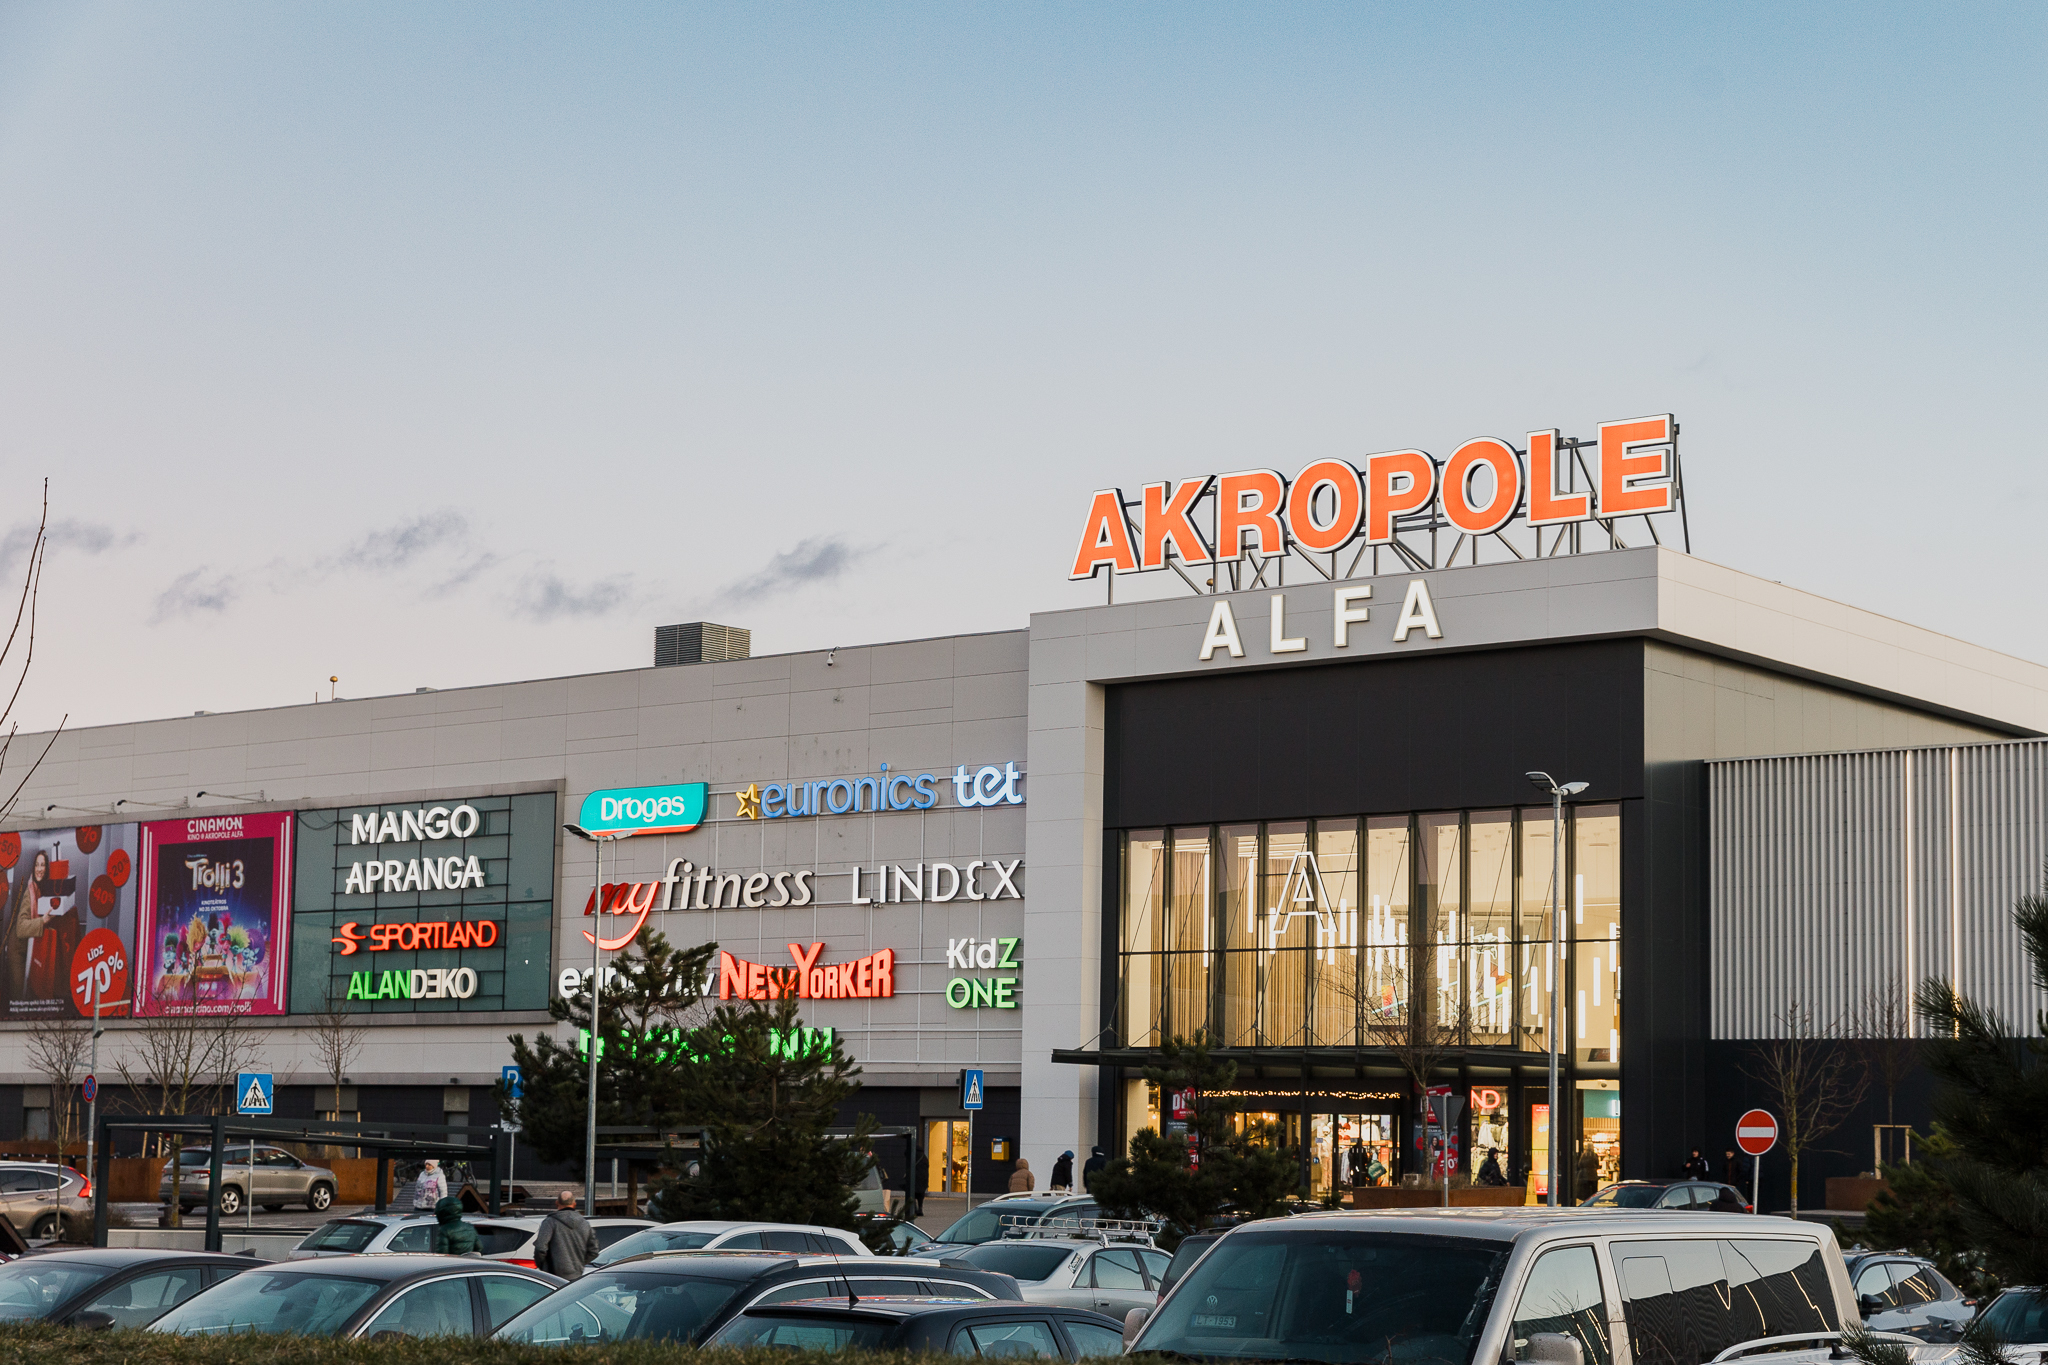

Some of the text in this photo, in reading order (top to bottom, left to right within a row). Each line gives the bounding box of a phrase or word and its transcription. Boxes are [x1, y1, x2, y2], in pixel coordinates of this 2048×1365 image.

[1068, 412, 1676, 581] AKROPOLE
[1198, 578, 1443, 661] ALFA
[760, 762, 939, 819] euronics
[952, 761, 1024, 808] tet
[351, 804, 480, 845] MANGO
[600, 795, 686, 823] Drogas
[232, 859, 245, 889] 3
[345, 855, 485, 895] APRANGA
[369, 920, 499, 951] SPORTLAND
[76, 951, 124, 1005] -70%
[945, 977, 1018, 1009] ONE
